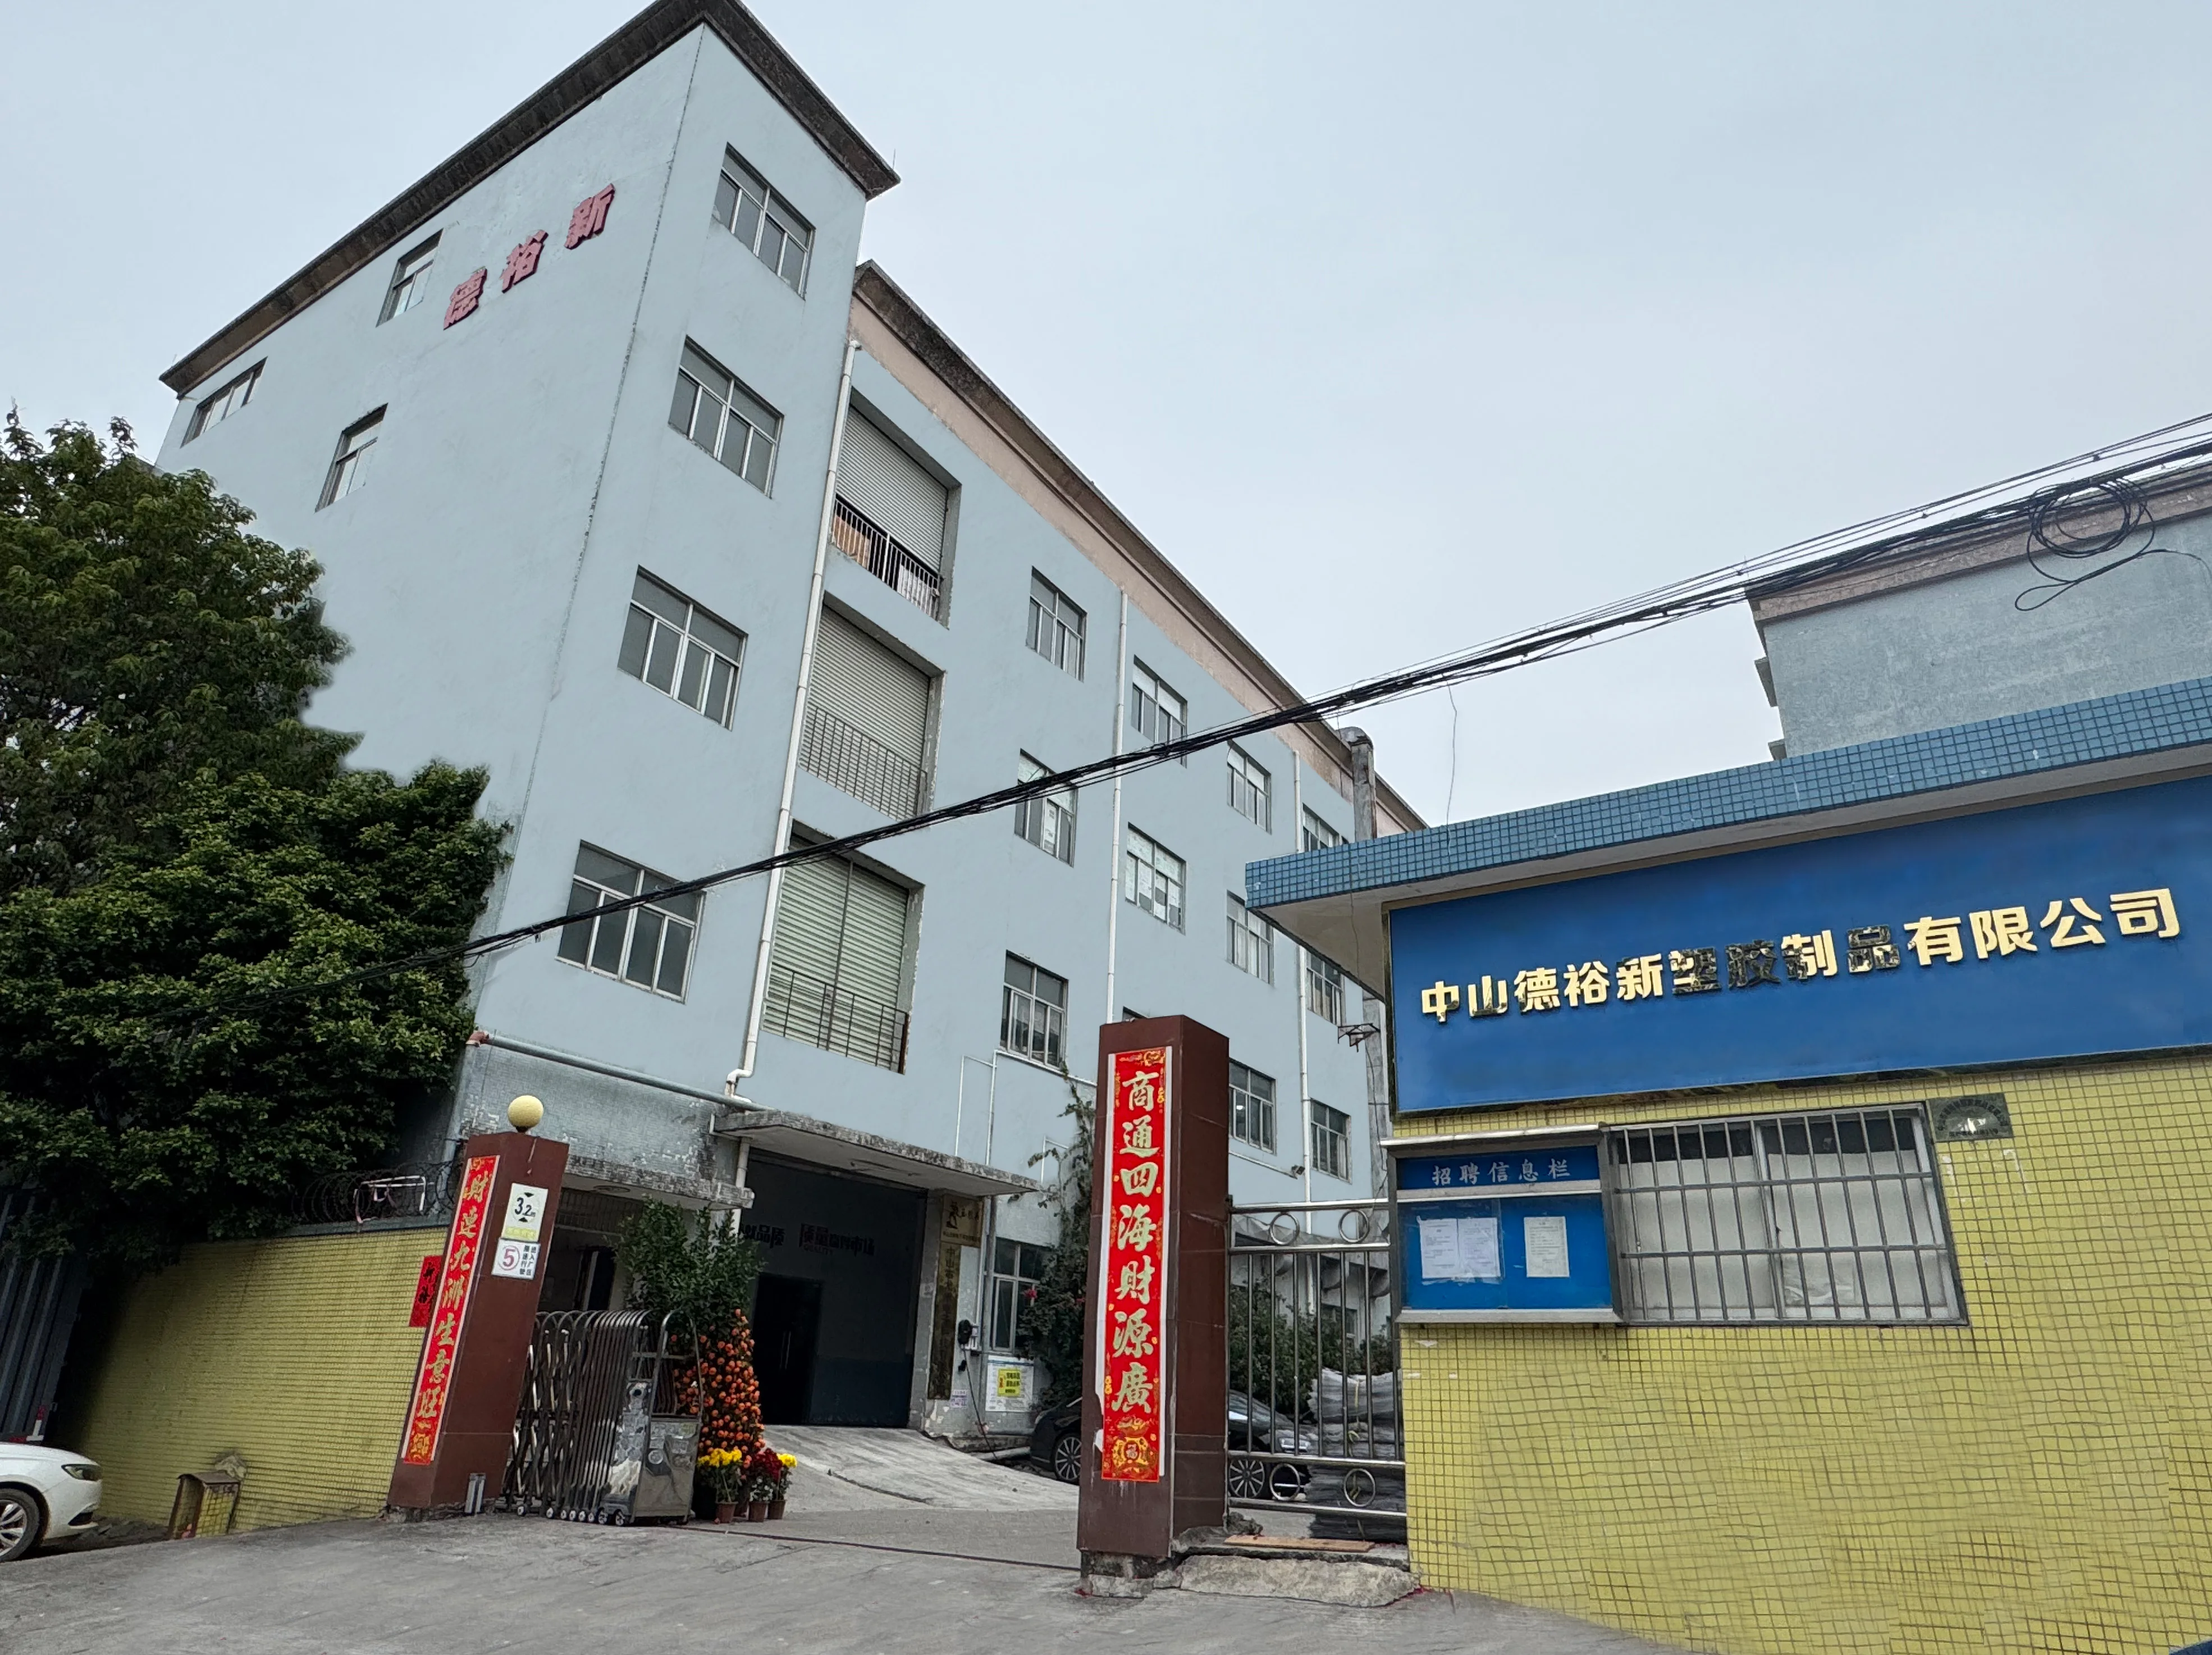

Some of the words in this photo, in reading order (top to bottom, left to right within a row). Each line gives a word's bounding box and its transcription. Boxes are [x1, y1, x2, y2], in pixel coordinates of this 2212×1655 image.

[444, 183, 615, 330] 德裕新
[1422, 888, 2180, 1023] 中山德裕新塑胶制品有限公司
[1432, 1159, 1570, 1186] 招聘信息栏
[502, 1248, 515, 1267] 5
[1111, 1069, 1159, 1414] 商通四海財源廣
